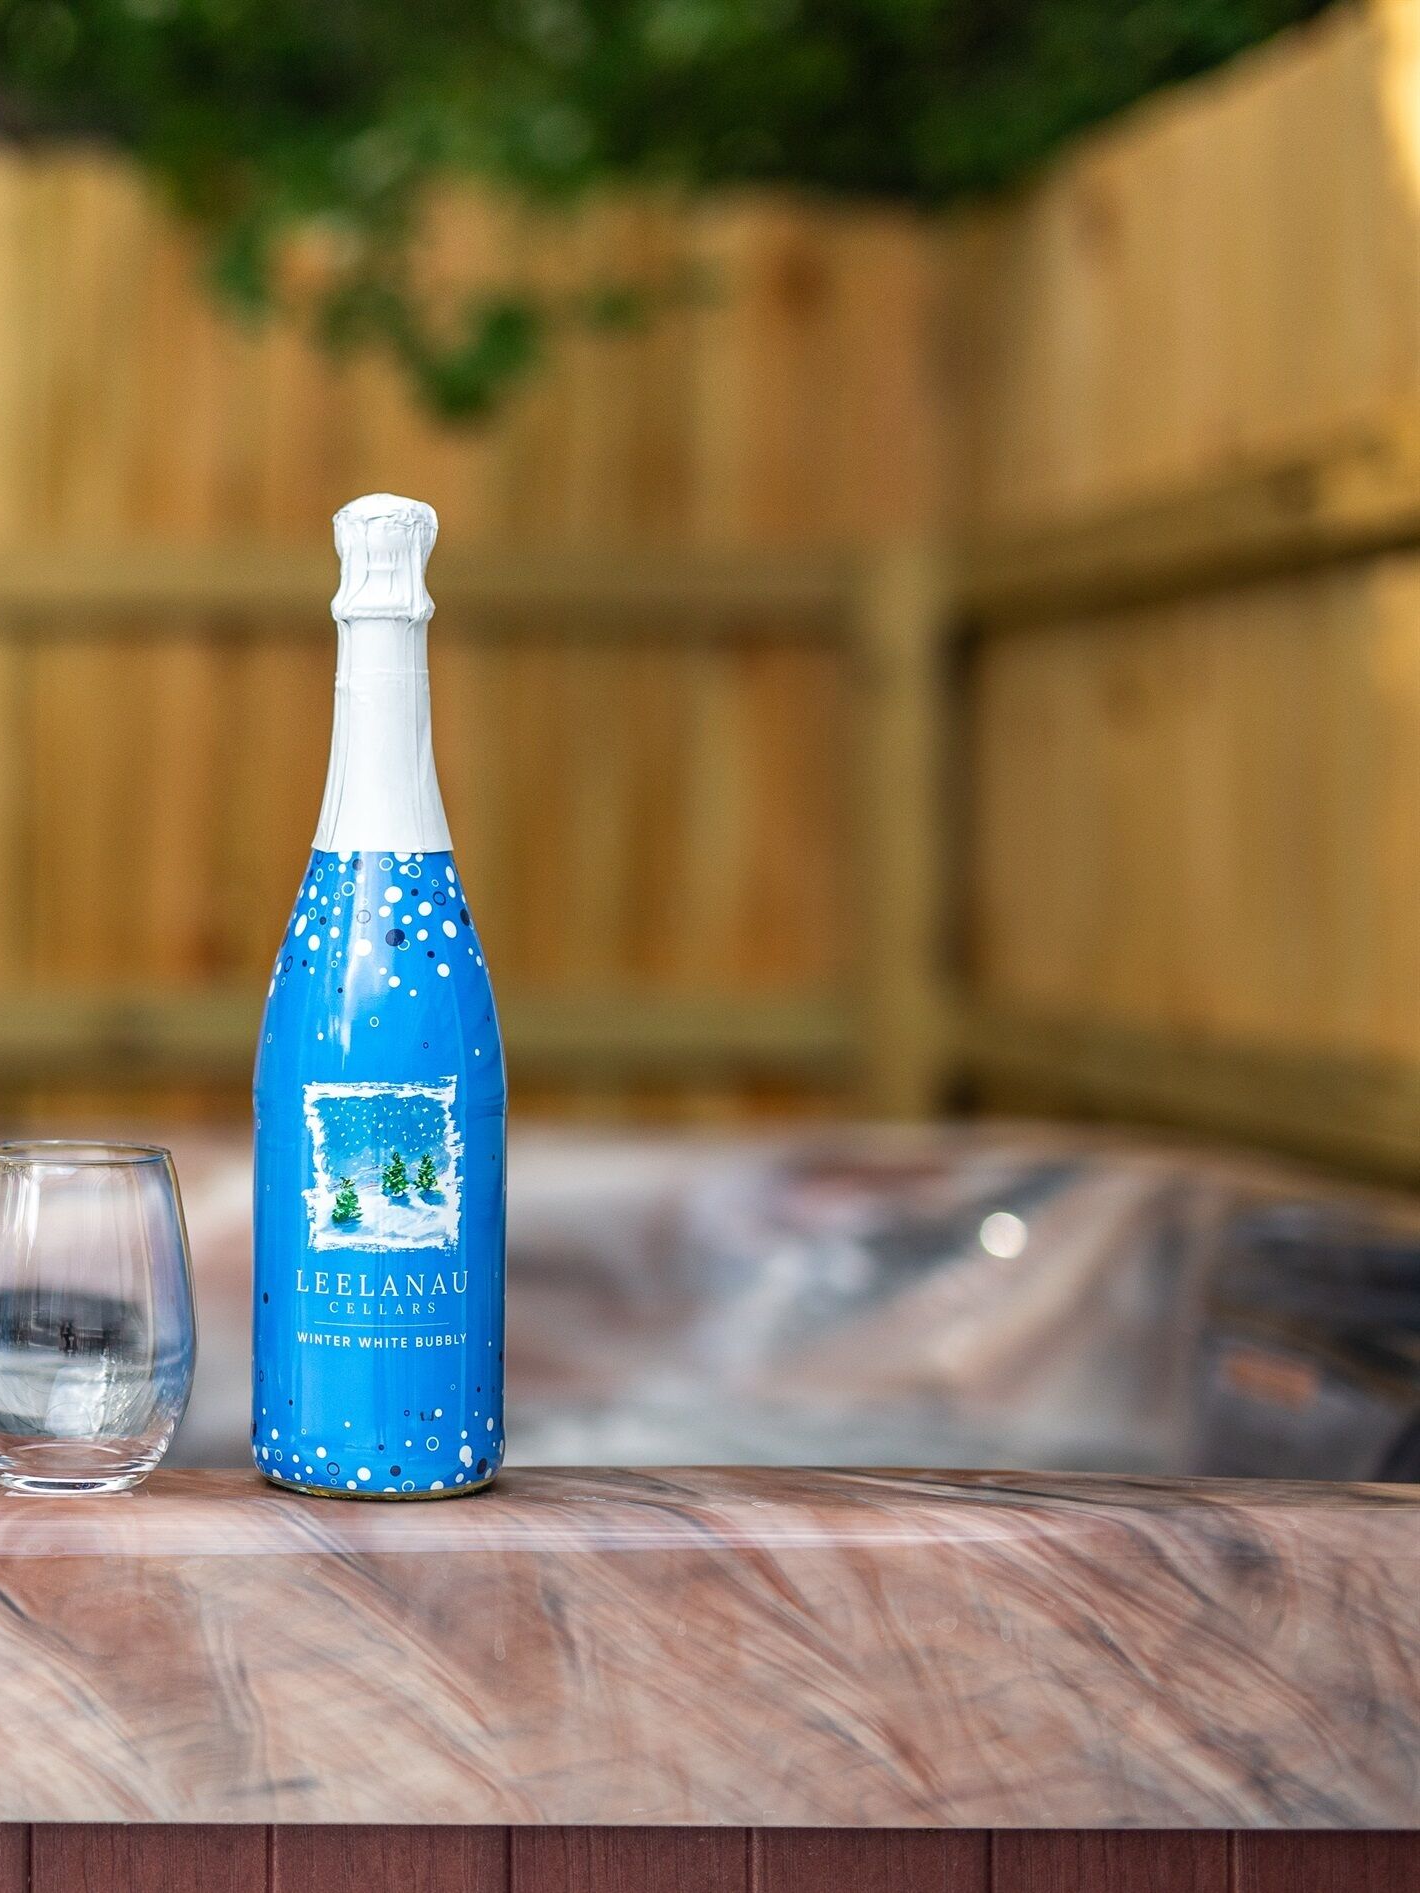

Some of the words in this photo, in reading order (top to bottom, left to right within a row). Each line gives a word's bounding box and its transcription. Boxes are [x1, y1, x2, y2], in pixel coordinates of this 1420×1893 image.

[296, 1269, 469, 1297] LEELANAU
[329, 1301, 436, 1315] CELLARS
[297, 1331, 351, 1347] WINTER
[358, 1337, 408, 1349] WHITE
[416, 1332, 467, 1348] BUBBLY
